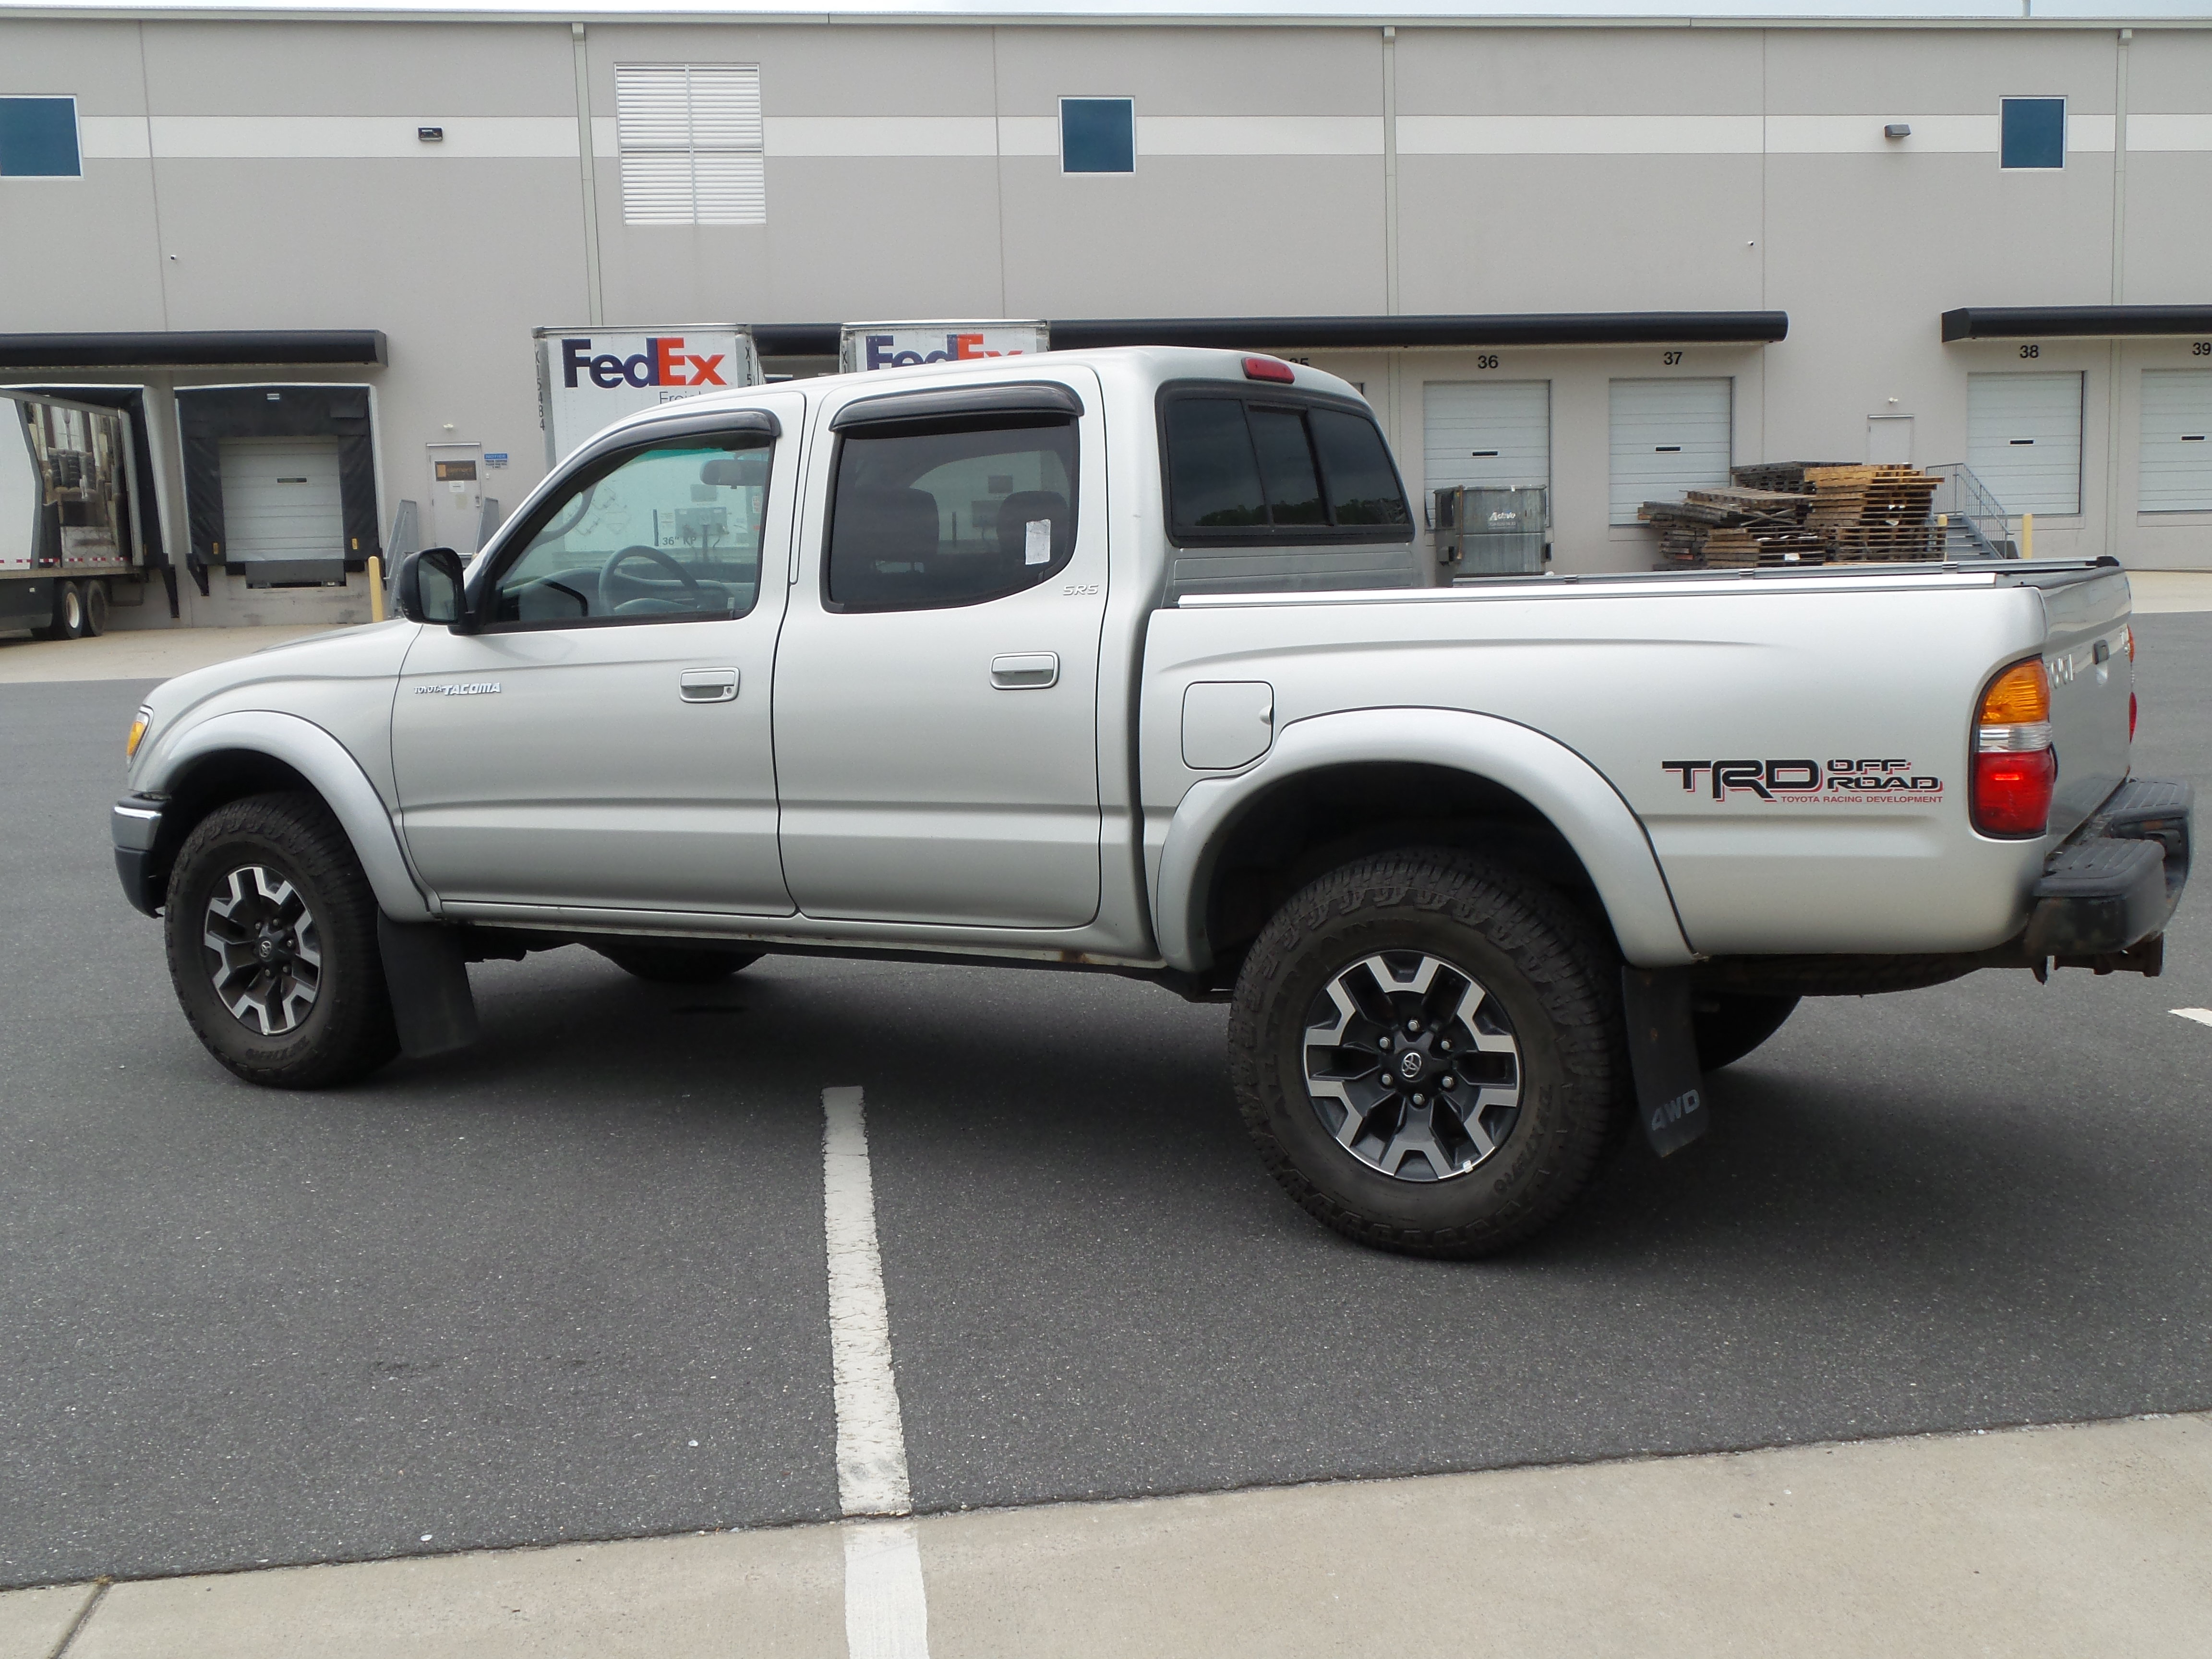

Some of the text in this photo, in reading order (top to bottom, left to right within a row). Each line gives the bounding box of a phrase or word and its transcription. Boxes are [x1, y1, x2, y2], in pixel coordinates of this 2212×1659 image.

[866, 334, 1023, 371] FedE
[2020, 345, 2038, 358] 38
[2192, 342, 2211, 355] 39
[562, 337, 727, 388] FedEx
[1478, 355, 1498, 369] 36
[1663, 351, 1682, 365] 37
[535, 350, 545, 431] X15484
[1063, 584, 1098, 595] SR5
[414, 682, 501, 696] TOYOTA TACOMA
[1662, 759, 1911, 803] TRD OFF
[1827, 776, 1943, 793] ROAD
[1651, 1089, 1700, 1131] 4WD
